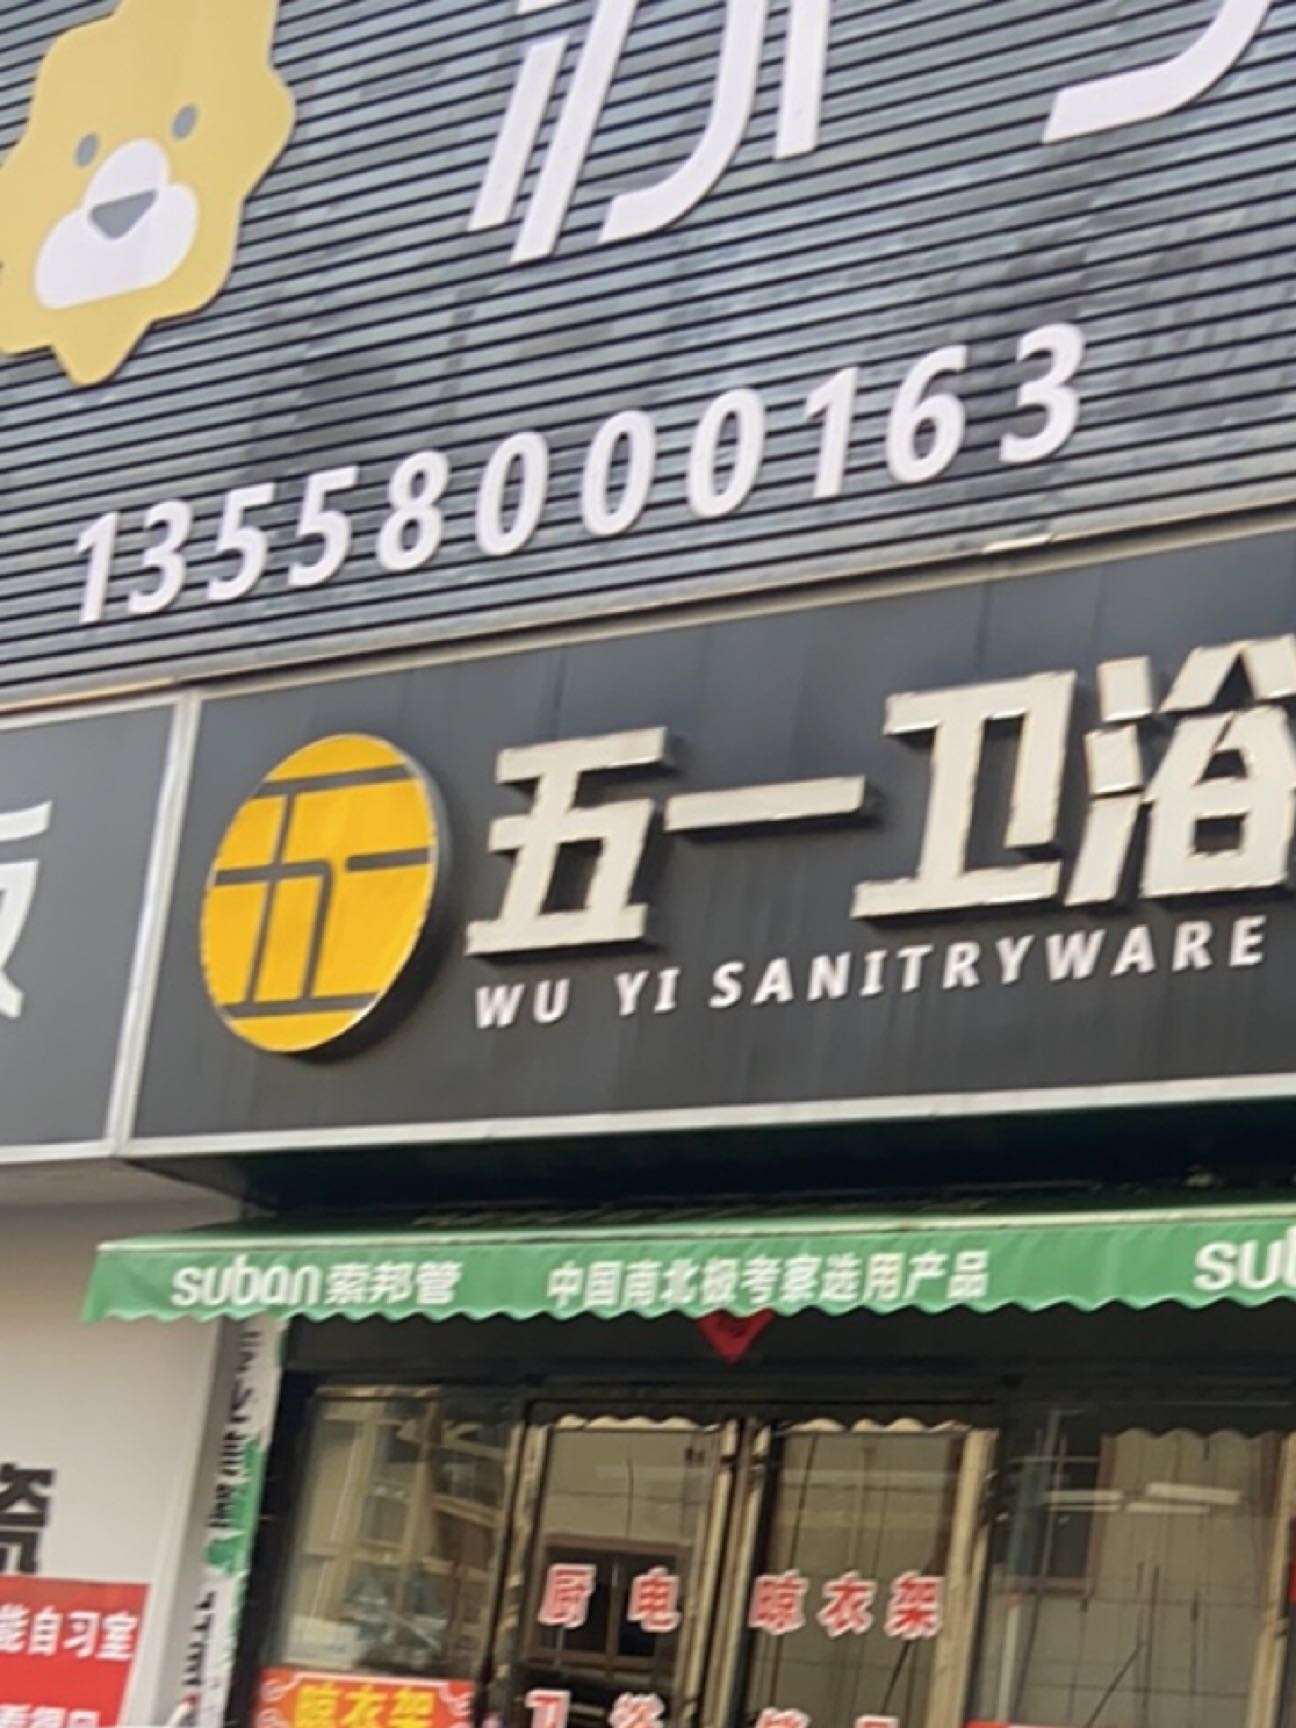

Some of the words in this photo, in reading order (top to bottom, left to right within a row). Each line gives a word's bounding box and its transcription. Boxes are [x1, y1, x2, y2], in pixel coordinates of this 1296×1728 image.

[74, 323, 1085, 625] 13558000163
[475, 978, 571, 1029] WU
[615, 966, 682, 1015] YI
[711, 915, 1268, 1009] SANITRYWARE
[172, 1255, 320, 1306] suban
[325, 1259, 463, 1306] 索邦管
[545, 1249, 990, 1309] 中国南北极考察选用产品
[538, 1563, 682, 1632] 厨电
[748, 1570, 944, 1640] 晾衣架
